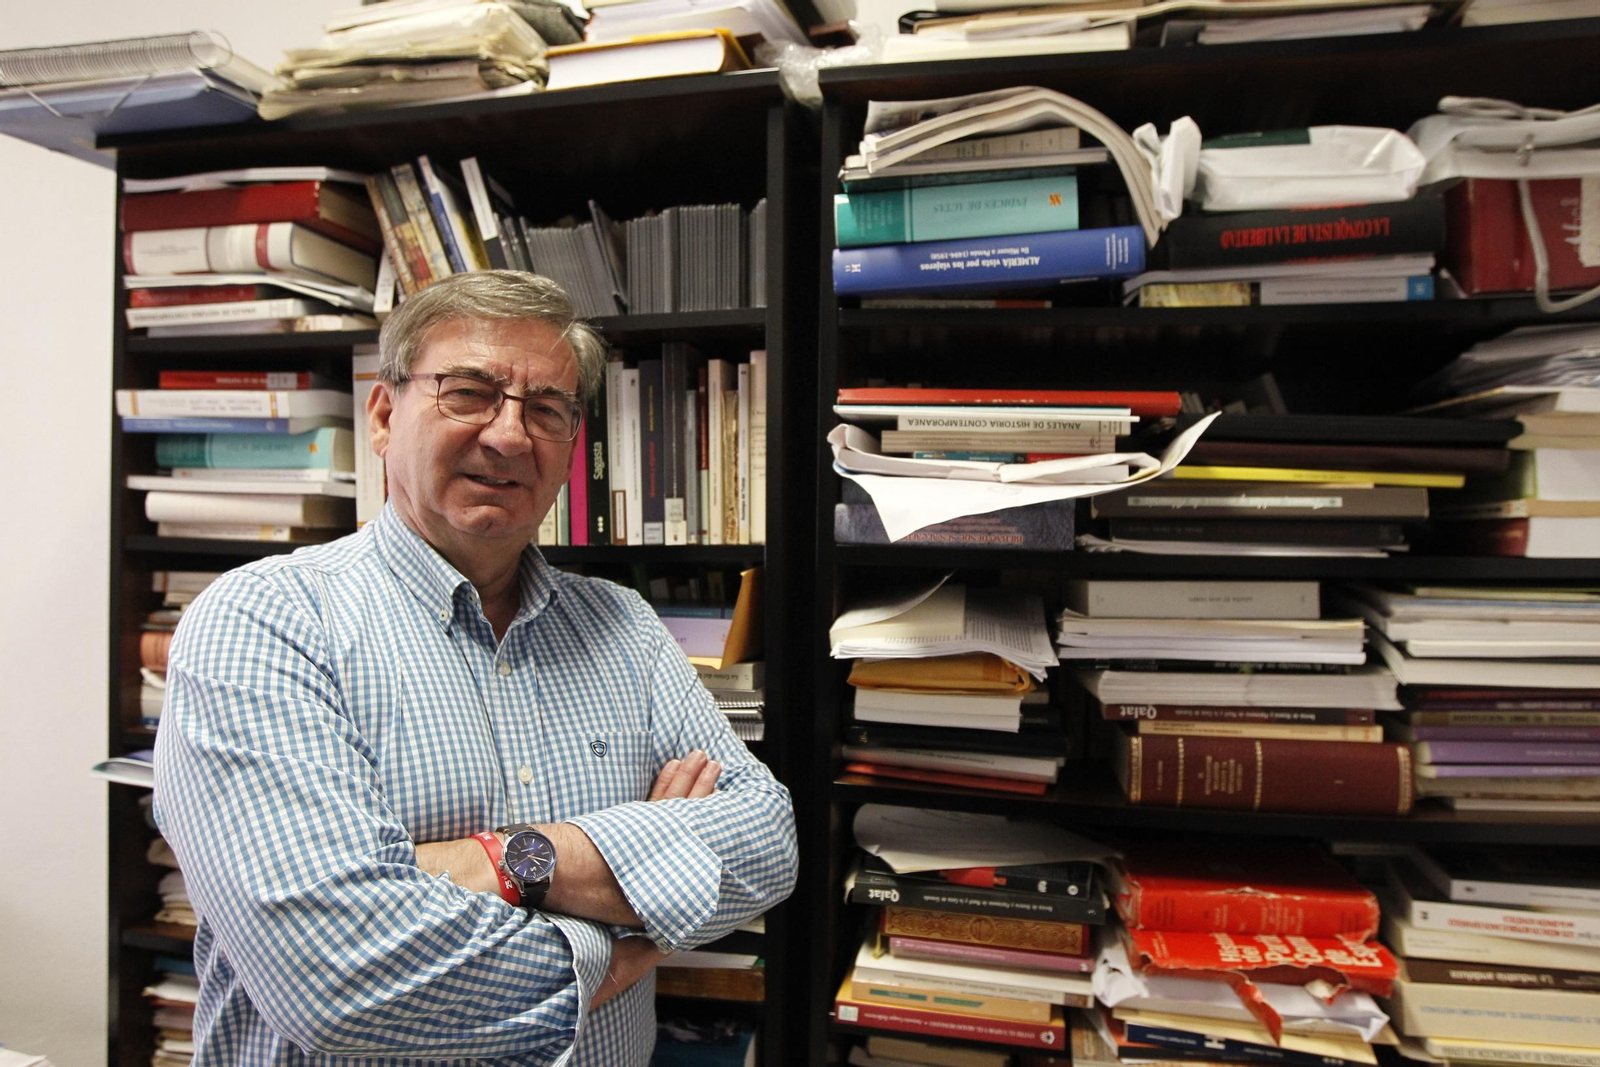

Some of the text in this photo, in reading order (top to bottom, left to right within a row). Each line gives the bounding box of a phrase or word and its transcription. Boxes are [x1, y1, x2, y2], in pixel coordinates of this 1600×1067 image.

[1220, 217, 1390, 249] LA CONQUISTA DE LA LIBERTAD
[920, 256, 1040, 272] ALMERÍA vista por los viajeros
[908, 418, 1081, 430] ANALES DE HISTORIA CONTEMPORANEA
[593, 441, 605, 480] Sagasta
[1120, 704, 1157, 719] Qalat
[868, 888, 900, 902] Qalat
